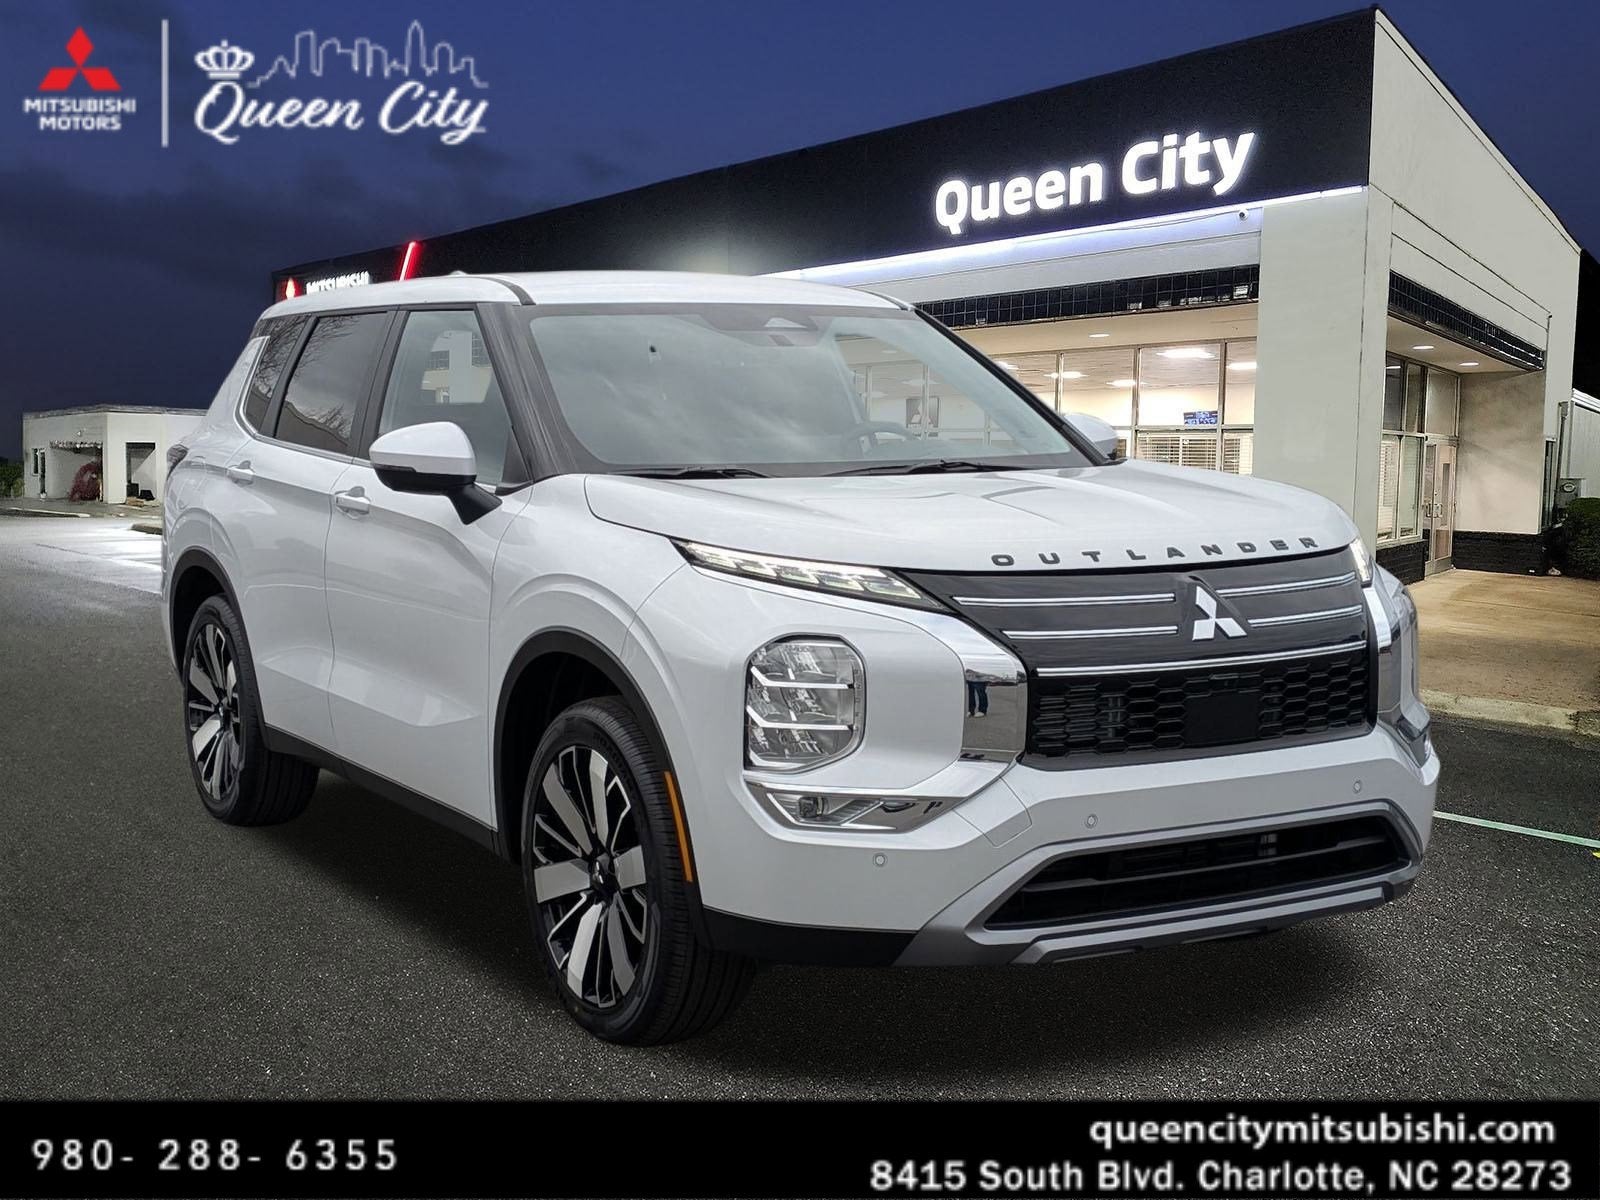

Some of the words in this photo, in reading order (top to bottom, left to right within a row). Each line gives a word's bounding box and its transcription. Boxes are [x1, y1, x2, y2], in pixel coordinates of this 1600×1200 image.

[935, 162, 1104, 235] Queen
[1121, 131, 1256, 196] City
[991, 537, 1319, 567] OUTLANDER
